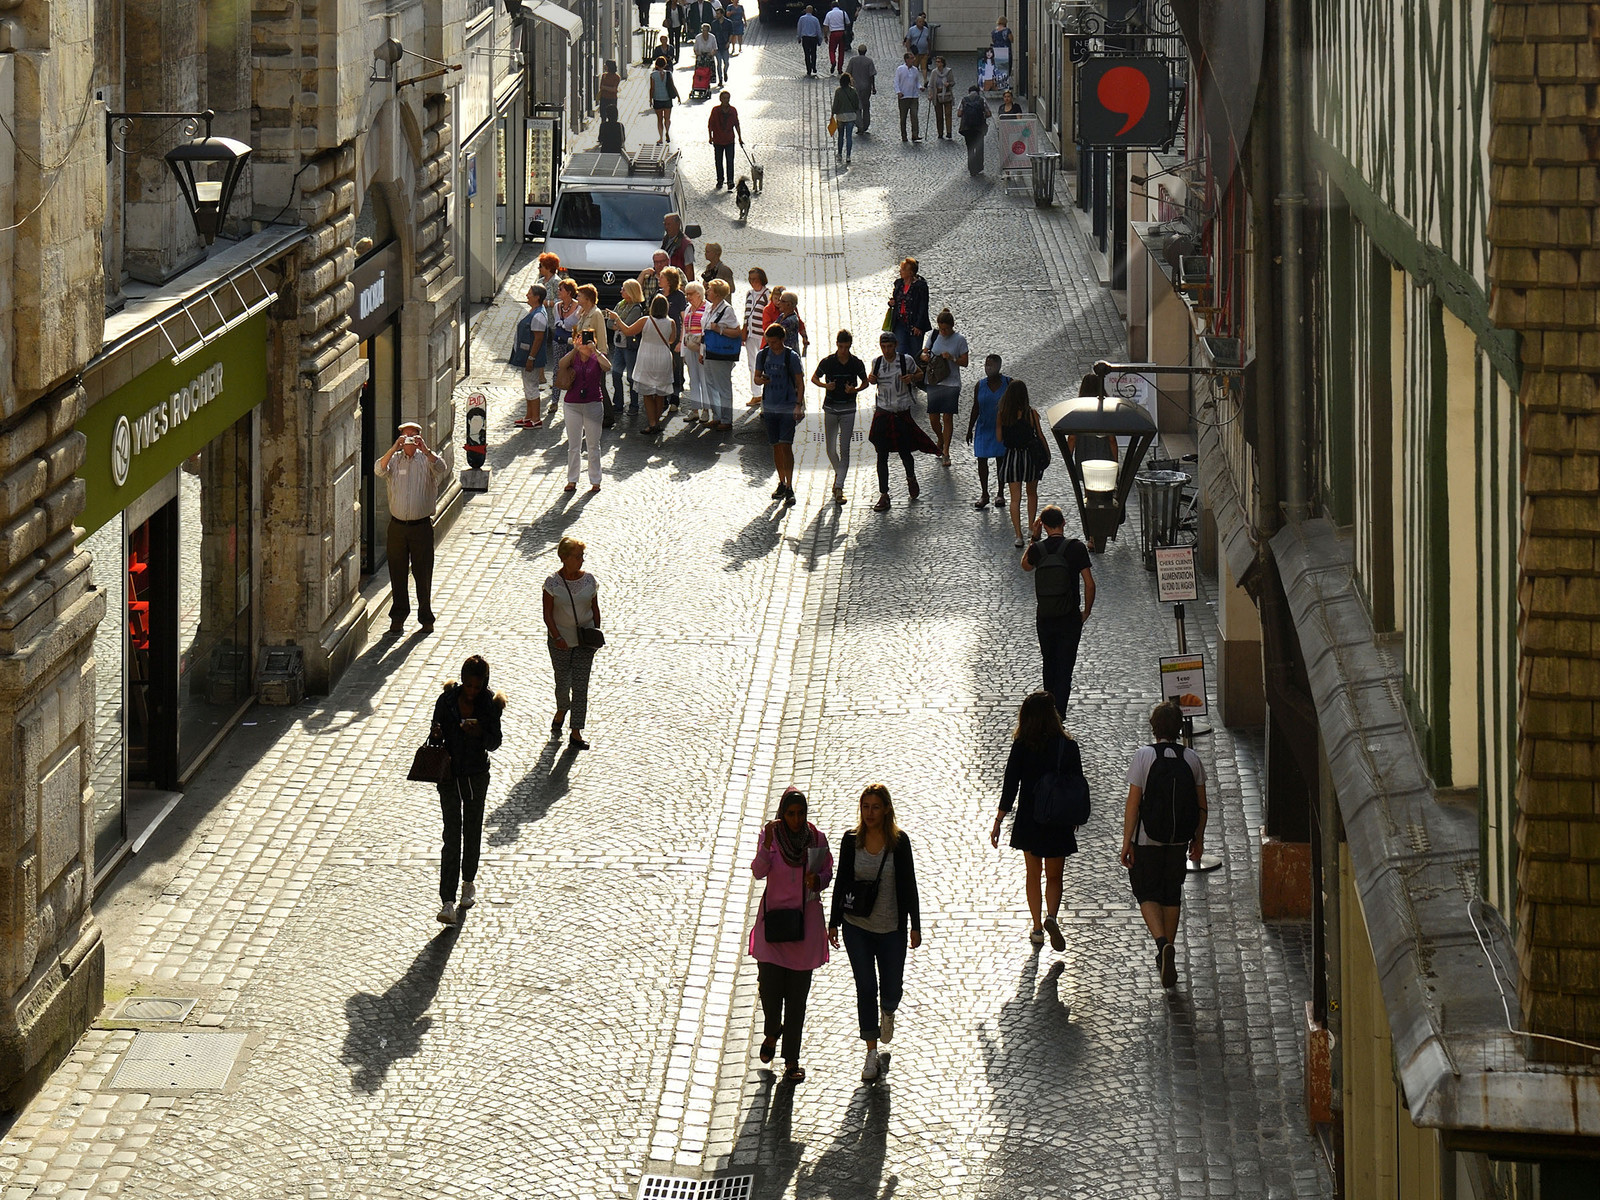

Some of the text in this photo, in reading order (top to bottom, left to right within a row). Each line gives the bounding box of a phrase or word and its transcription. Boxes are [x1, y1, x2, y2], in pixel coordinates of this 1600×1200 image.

[469, 395, 485, 406] BUD
[131, 362, 224, 455] YVES ROCHER
[1162, 571, 1194, 580] ALIMENTATION
